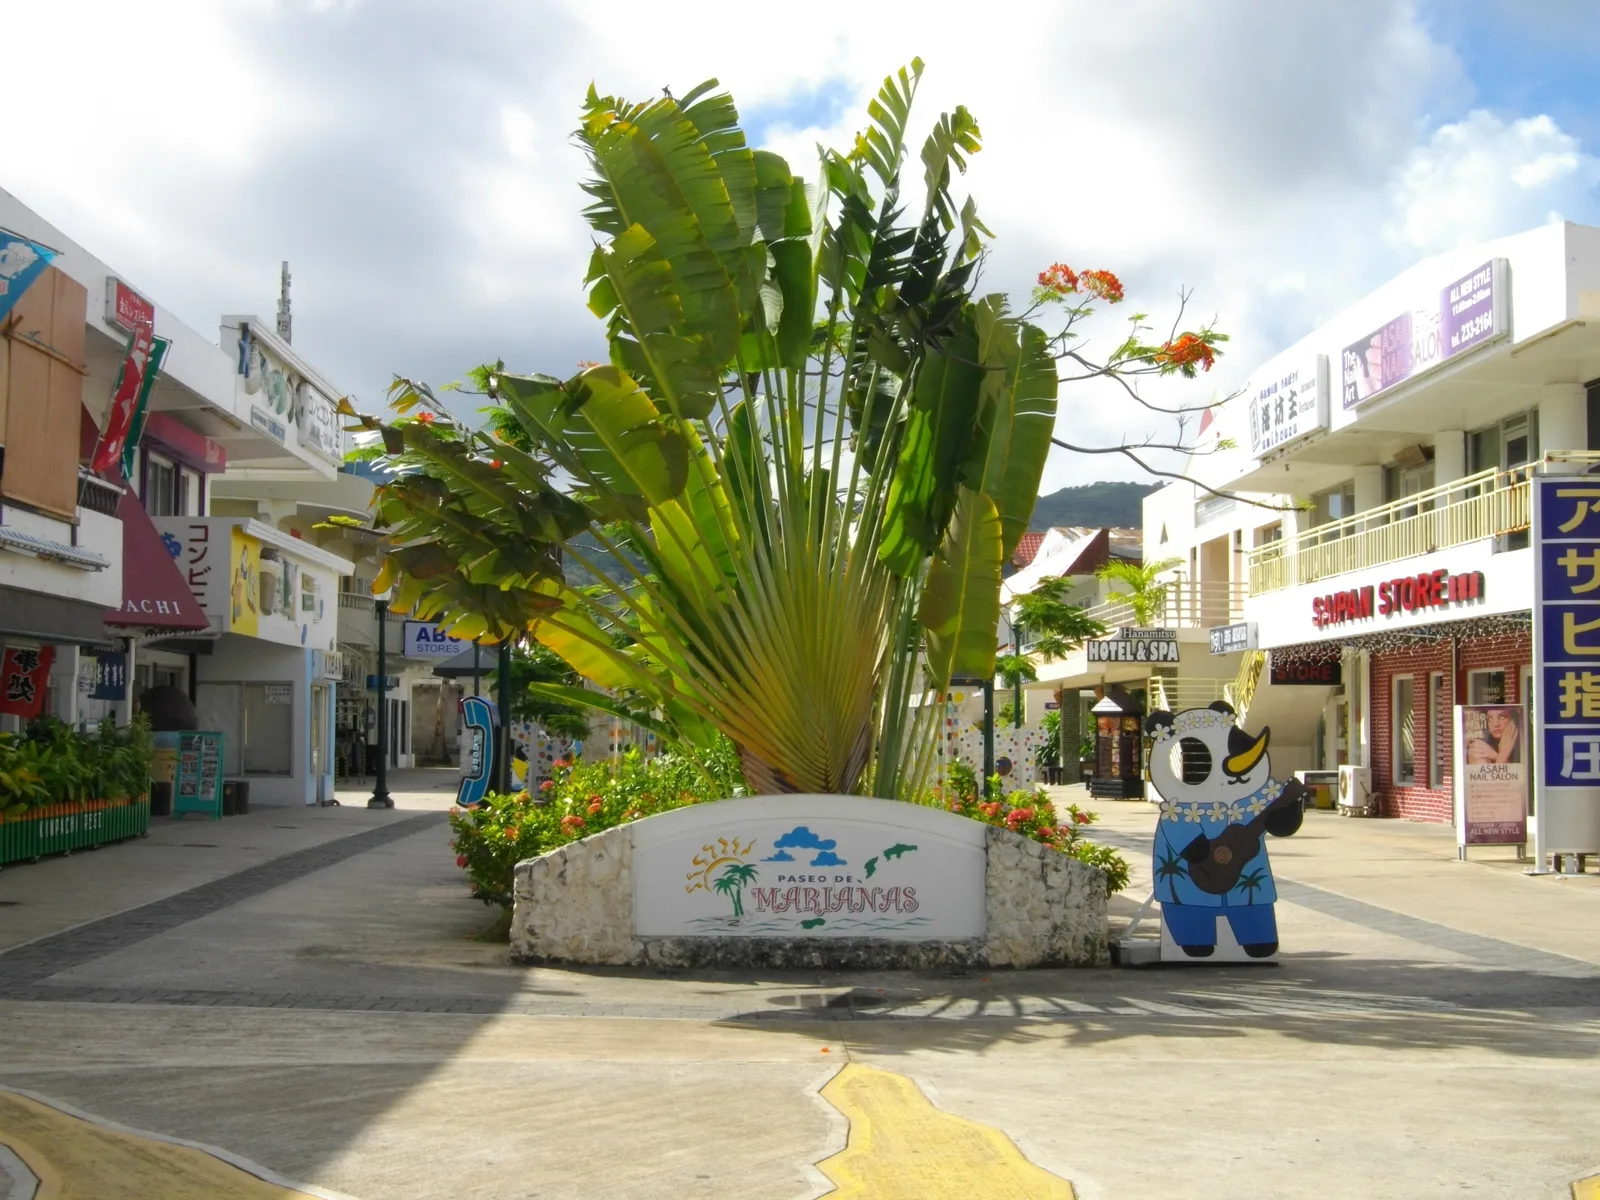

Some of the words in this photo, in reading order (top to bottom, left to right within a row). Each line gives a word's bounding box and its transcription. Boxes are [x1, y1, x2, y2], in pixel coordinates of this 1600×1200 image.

[1450, 286, 1461, 304] ALL
[1472, 267, 1491, 291] STYLE
[1461, 309, 1493, 343] 233-2164
[1343, 350, 1357, 369] The
[1409, 328, 1443, 372] SALON
[1344, 385, 1356, 404] Art
[188, 525, 211, 607] コンビニ
[116, 599, 181, 615] ACHI
[1312, 585, 1374, 627] SAIPAN
[1378, 568, 1448, 616] STORE
[1122, 628, 1176, 639] Hanamitsu
[417, 644, 460, 653] STORES
[1149, 641, 1179, 662] SPA
[1276, 665, 1333, 681] STORE
[1470, 773, 1489, 781] NAIL
[1491, 772, 1519, 781] SALON
[1480, 765, 1509, 774] ASAHI
[1470, 828, 1483, 836] ALL
[1500, 827, 1520, 835] STYLE
[778, 875, 827, 883] PASEO
[834, 875, 853, 883] DE
[751, 886, 920, 916] MARIANAS
